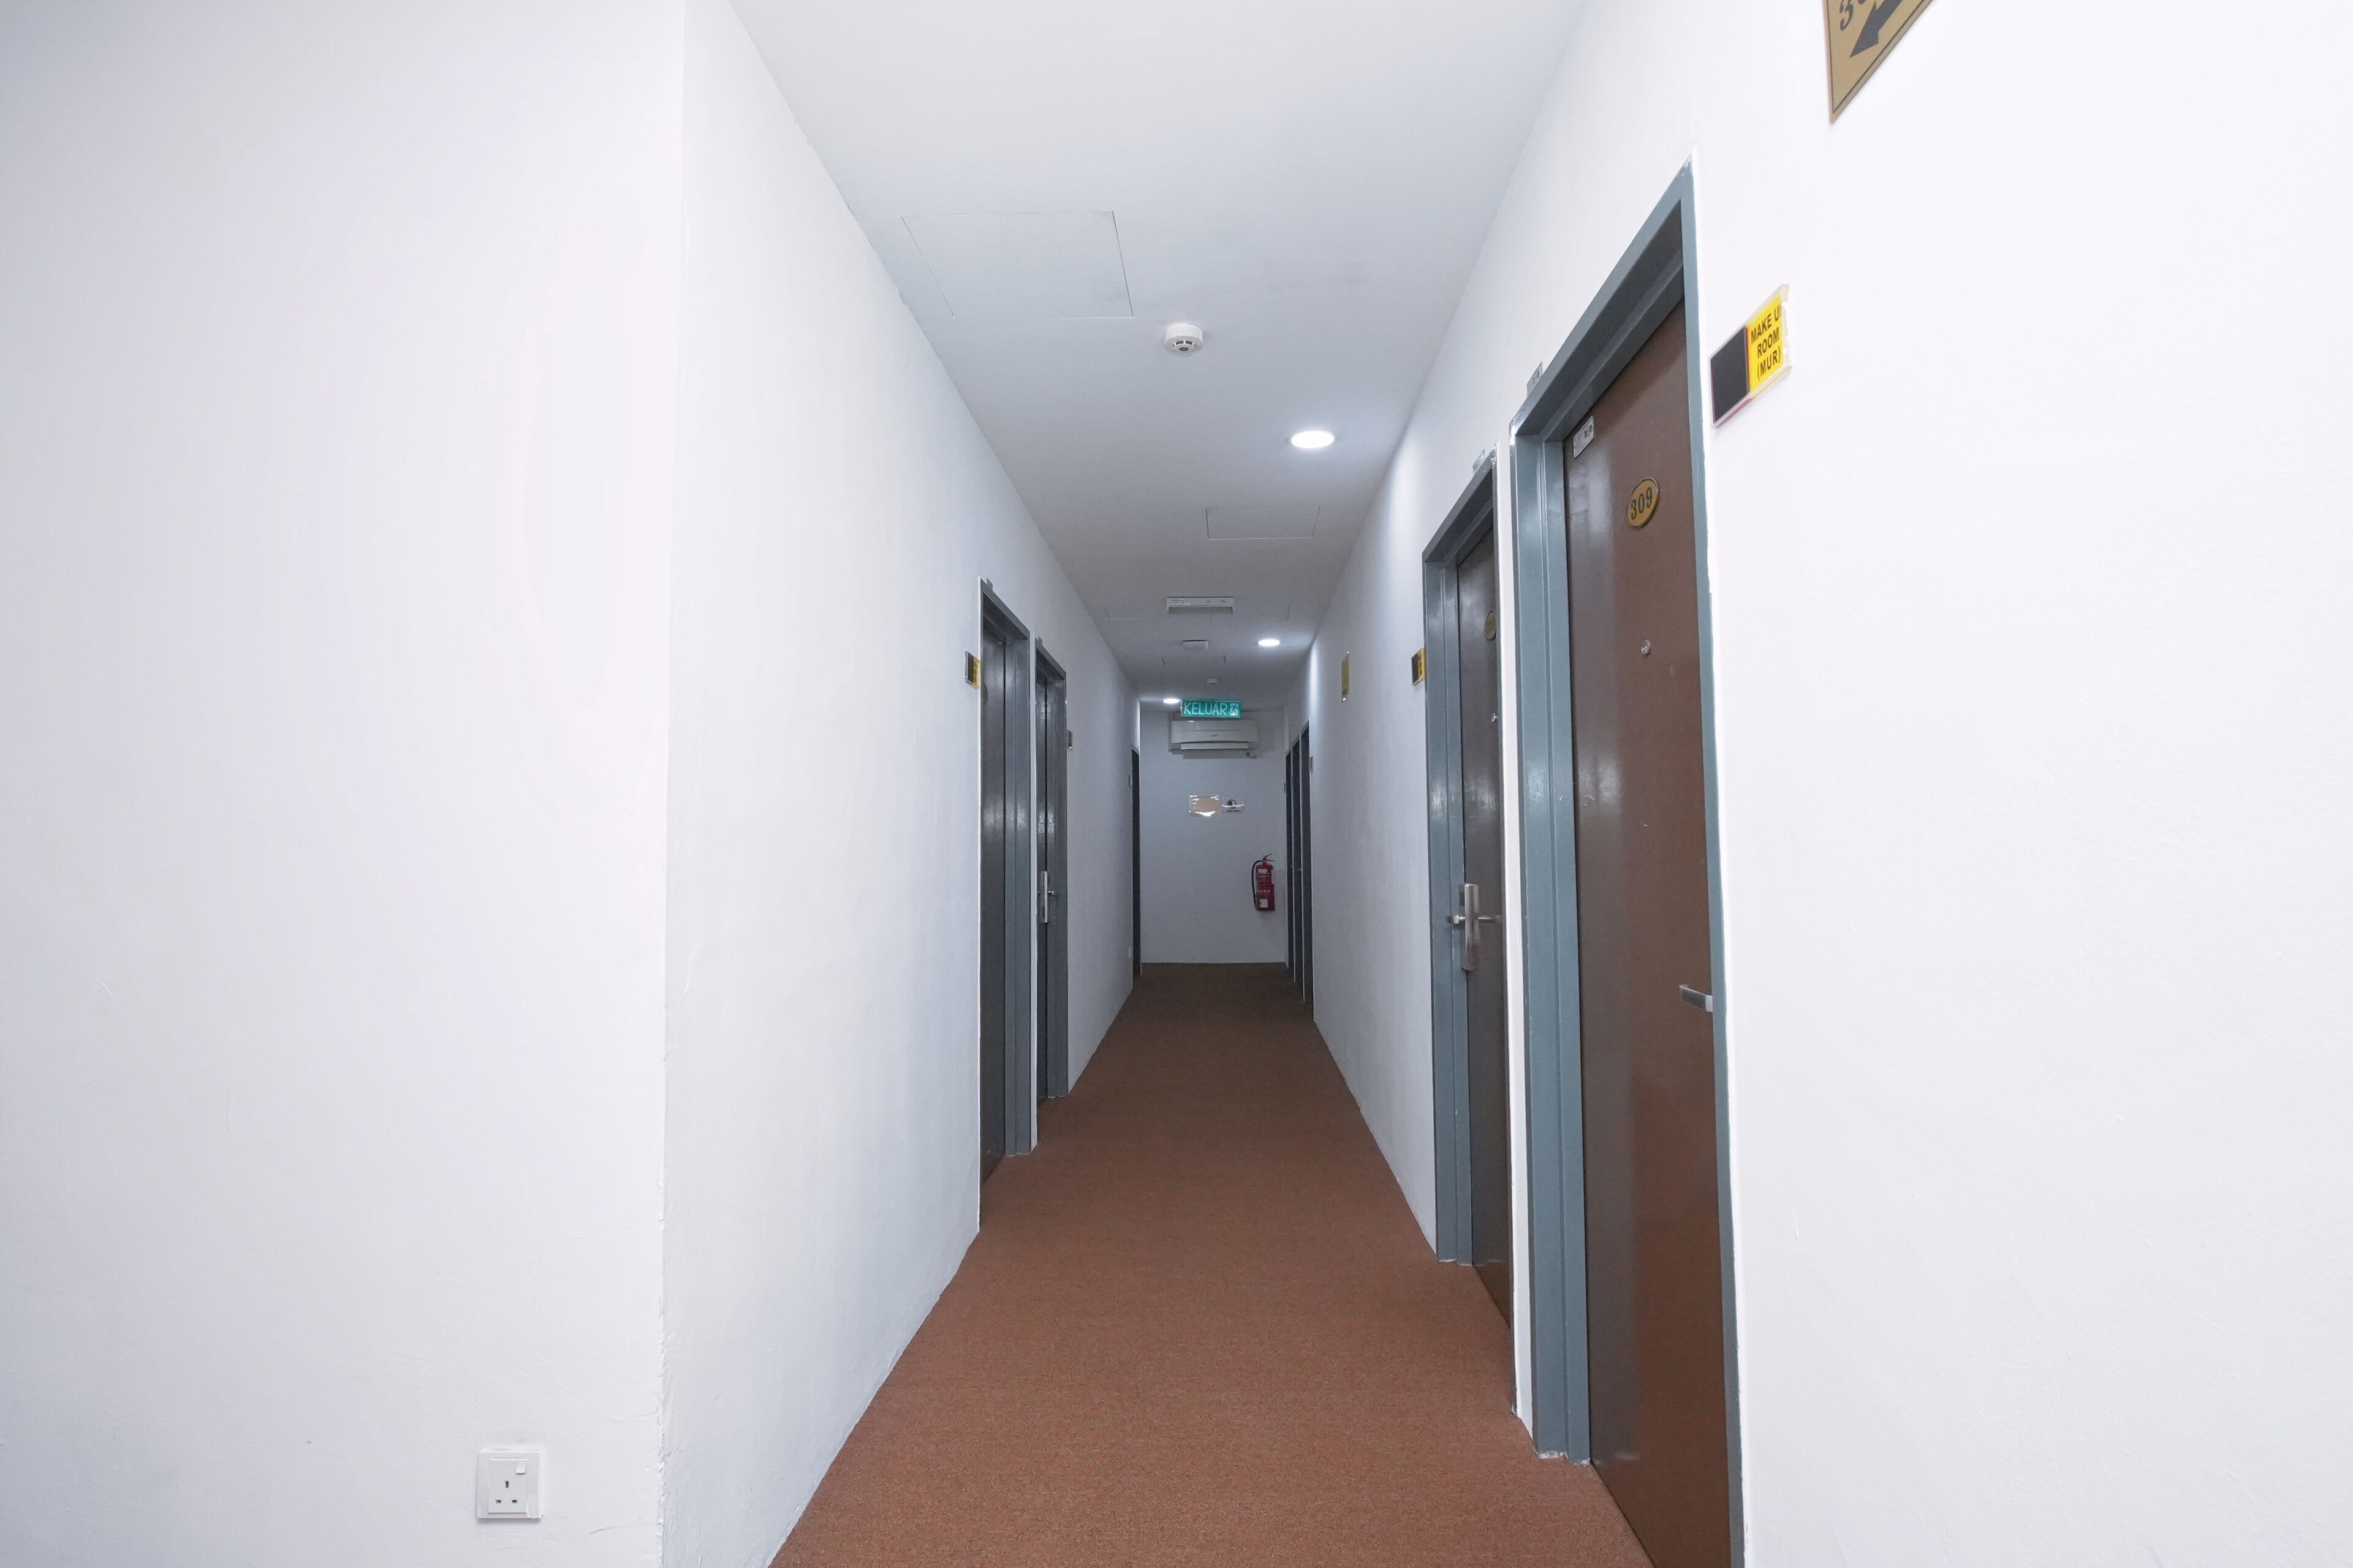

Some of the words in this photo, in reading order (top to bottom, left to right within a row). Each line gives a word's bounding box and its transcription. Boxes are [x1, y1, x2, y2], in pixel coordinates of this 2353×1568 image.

[1751, 312, 1772, 344] MAKE
[1757, 327, 1779, 358] ROOM
[1757, 345, 1781, 381] (MUR)
[1631, 487, 1653, 520] 309
[1184, 702, 1228, 716] KELUAR
